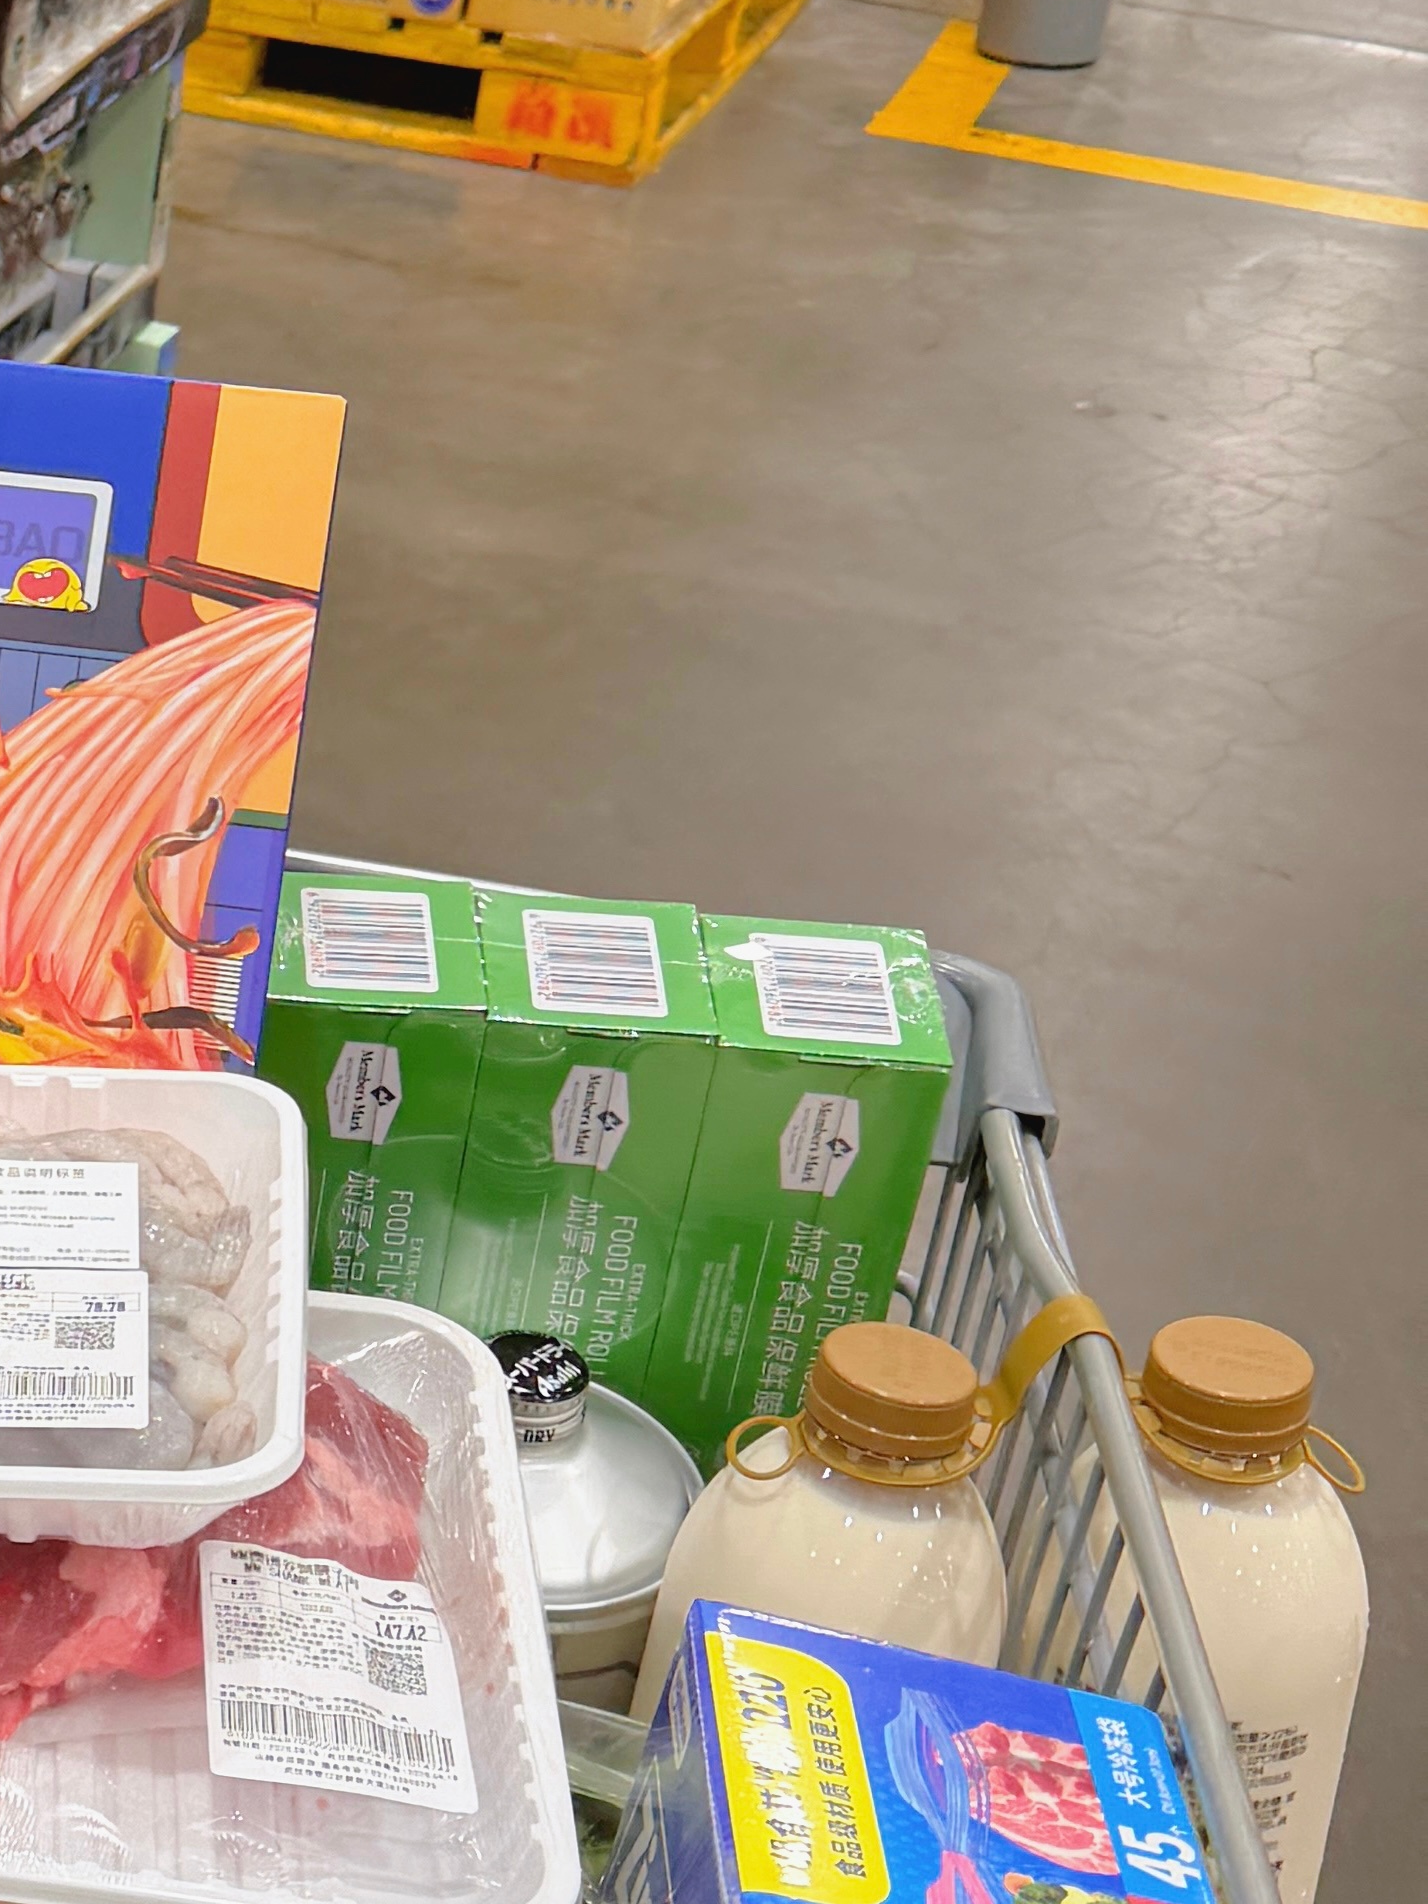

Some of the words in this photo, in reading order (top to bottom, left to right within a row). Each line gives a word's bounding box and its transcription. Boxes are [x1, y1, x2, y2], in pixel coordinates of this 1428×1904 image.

[384, 1190, 415, 1246] FOOD
[605, 1215, 638, 1272] FOOD
[546, 1194, 605, 1351] 加厚食品保
[591, 1277, 625, 1326] FILM
[619, 1263, 647, 1341] EXTRA-THICK
[827, 1242, 863, 1299] FOOD
[751, 1220, 831, 1415] 加厚食品保鲜膜
[524, 1428, 556, 1443] DRY
[801, 1684, 847, 1776] 使用更安心
[1097, 1717, 1150, 1811] 大号冷冻袋
[824, 1778, 868, 1883] 食品级材质
